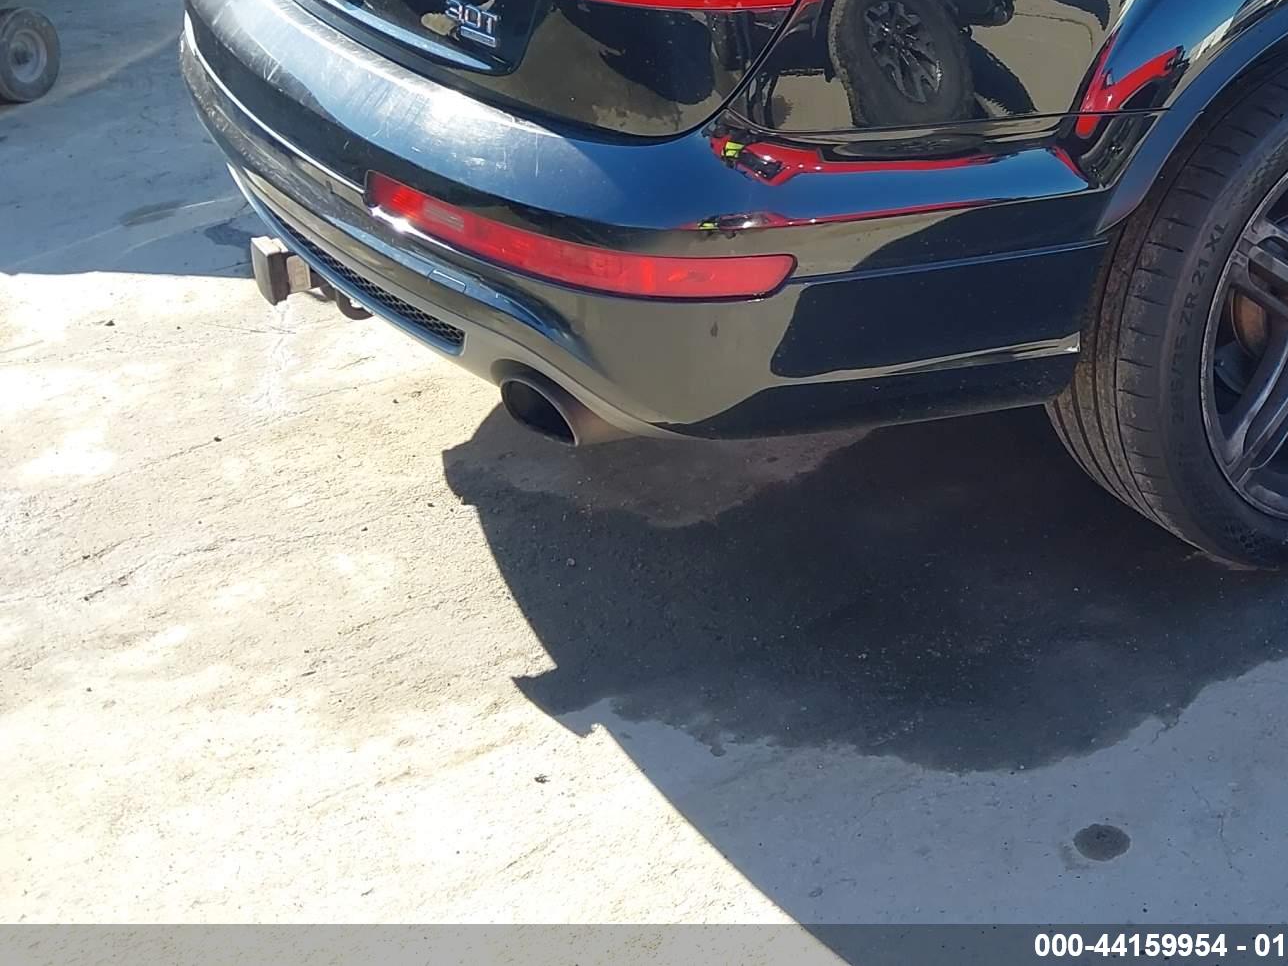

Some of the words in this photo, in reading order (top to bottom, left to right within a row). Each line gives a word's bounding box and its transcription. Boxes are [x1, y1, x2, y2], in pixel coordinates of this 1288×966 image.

[1179, 292, 1200, 325] ZR
[1191, 258, 1209, 286] 21
[1204, 222, 1230, 253] XL
